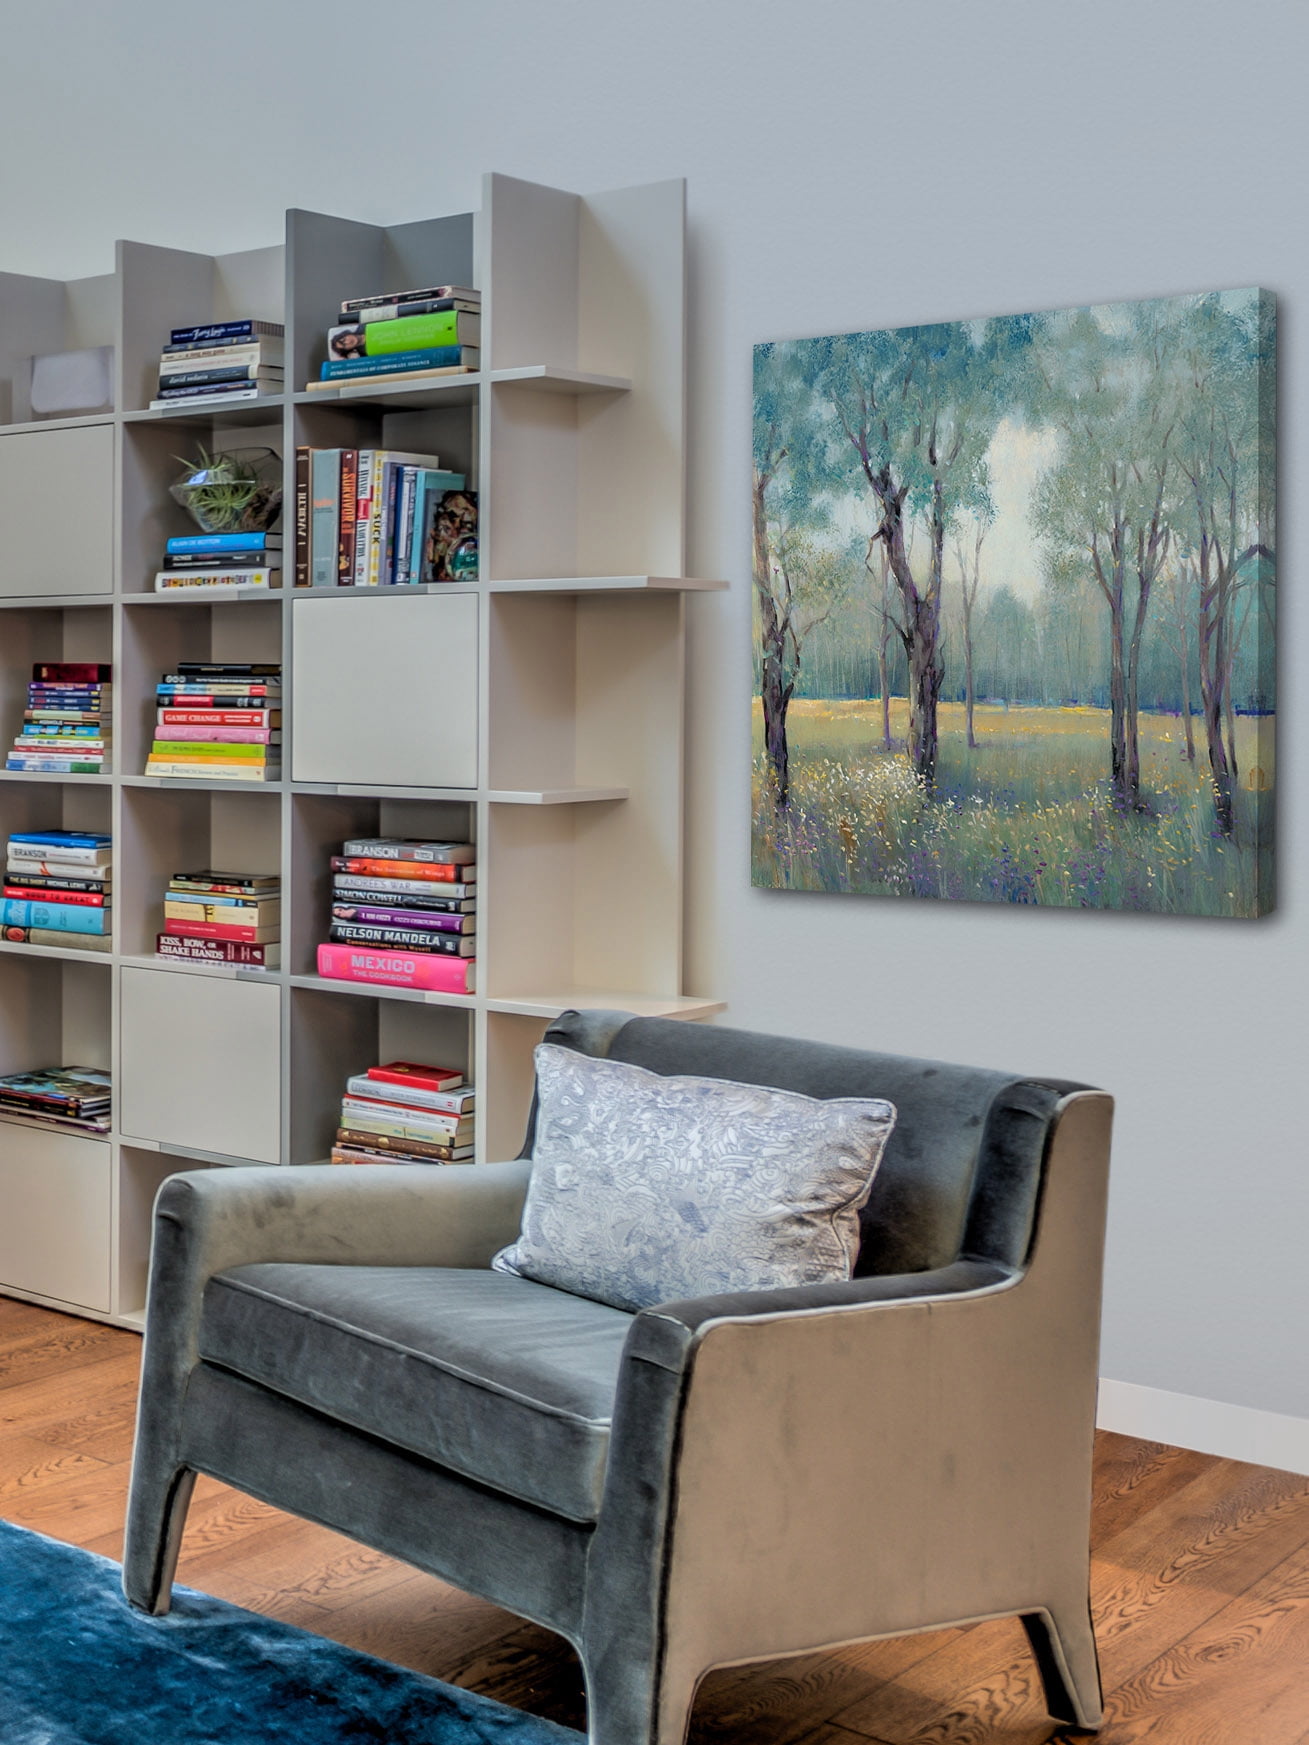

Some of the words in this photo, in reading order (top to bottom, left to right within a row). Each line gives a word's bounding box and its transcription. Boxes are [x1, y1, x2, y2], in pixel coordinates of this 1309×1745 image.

[372, 513, 381, 545] SUCK
[165, 714, 188, 722] GAME
[189, 714, 222, 722] CHANGE
[14, 848, 48, 859] BRANSON
[390, 881, 411, 890] WAR
[335, 889, 367, 900] SIMON
[367, 891, 402, 902] COWELL
[337, 926, 382, 940] NELSON
[385, 931, 440, 946] MANDELA
[159, 945, 190, 956] SHAKE
[191, 947, 224, 960] HANDS
[351, 954, 416, 973] MEXICO
[353, 969, 366, 977] THE
[368, 971, 413, 983] COOKBOOK
